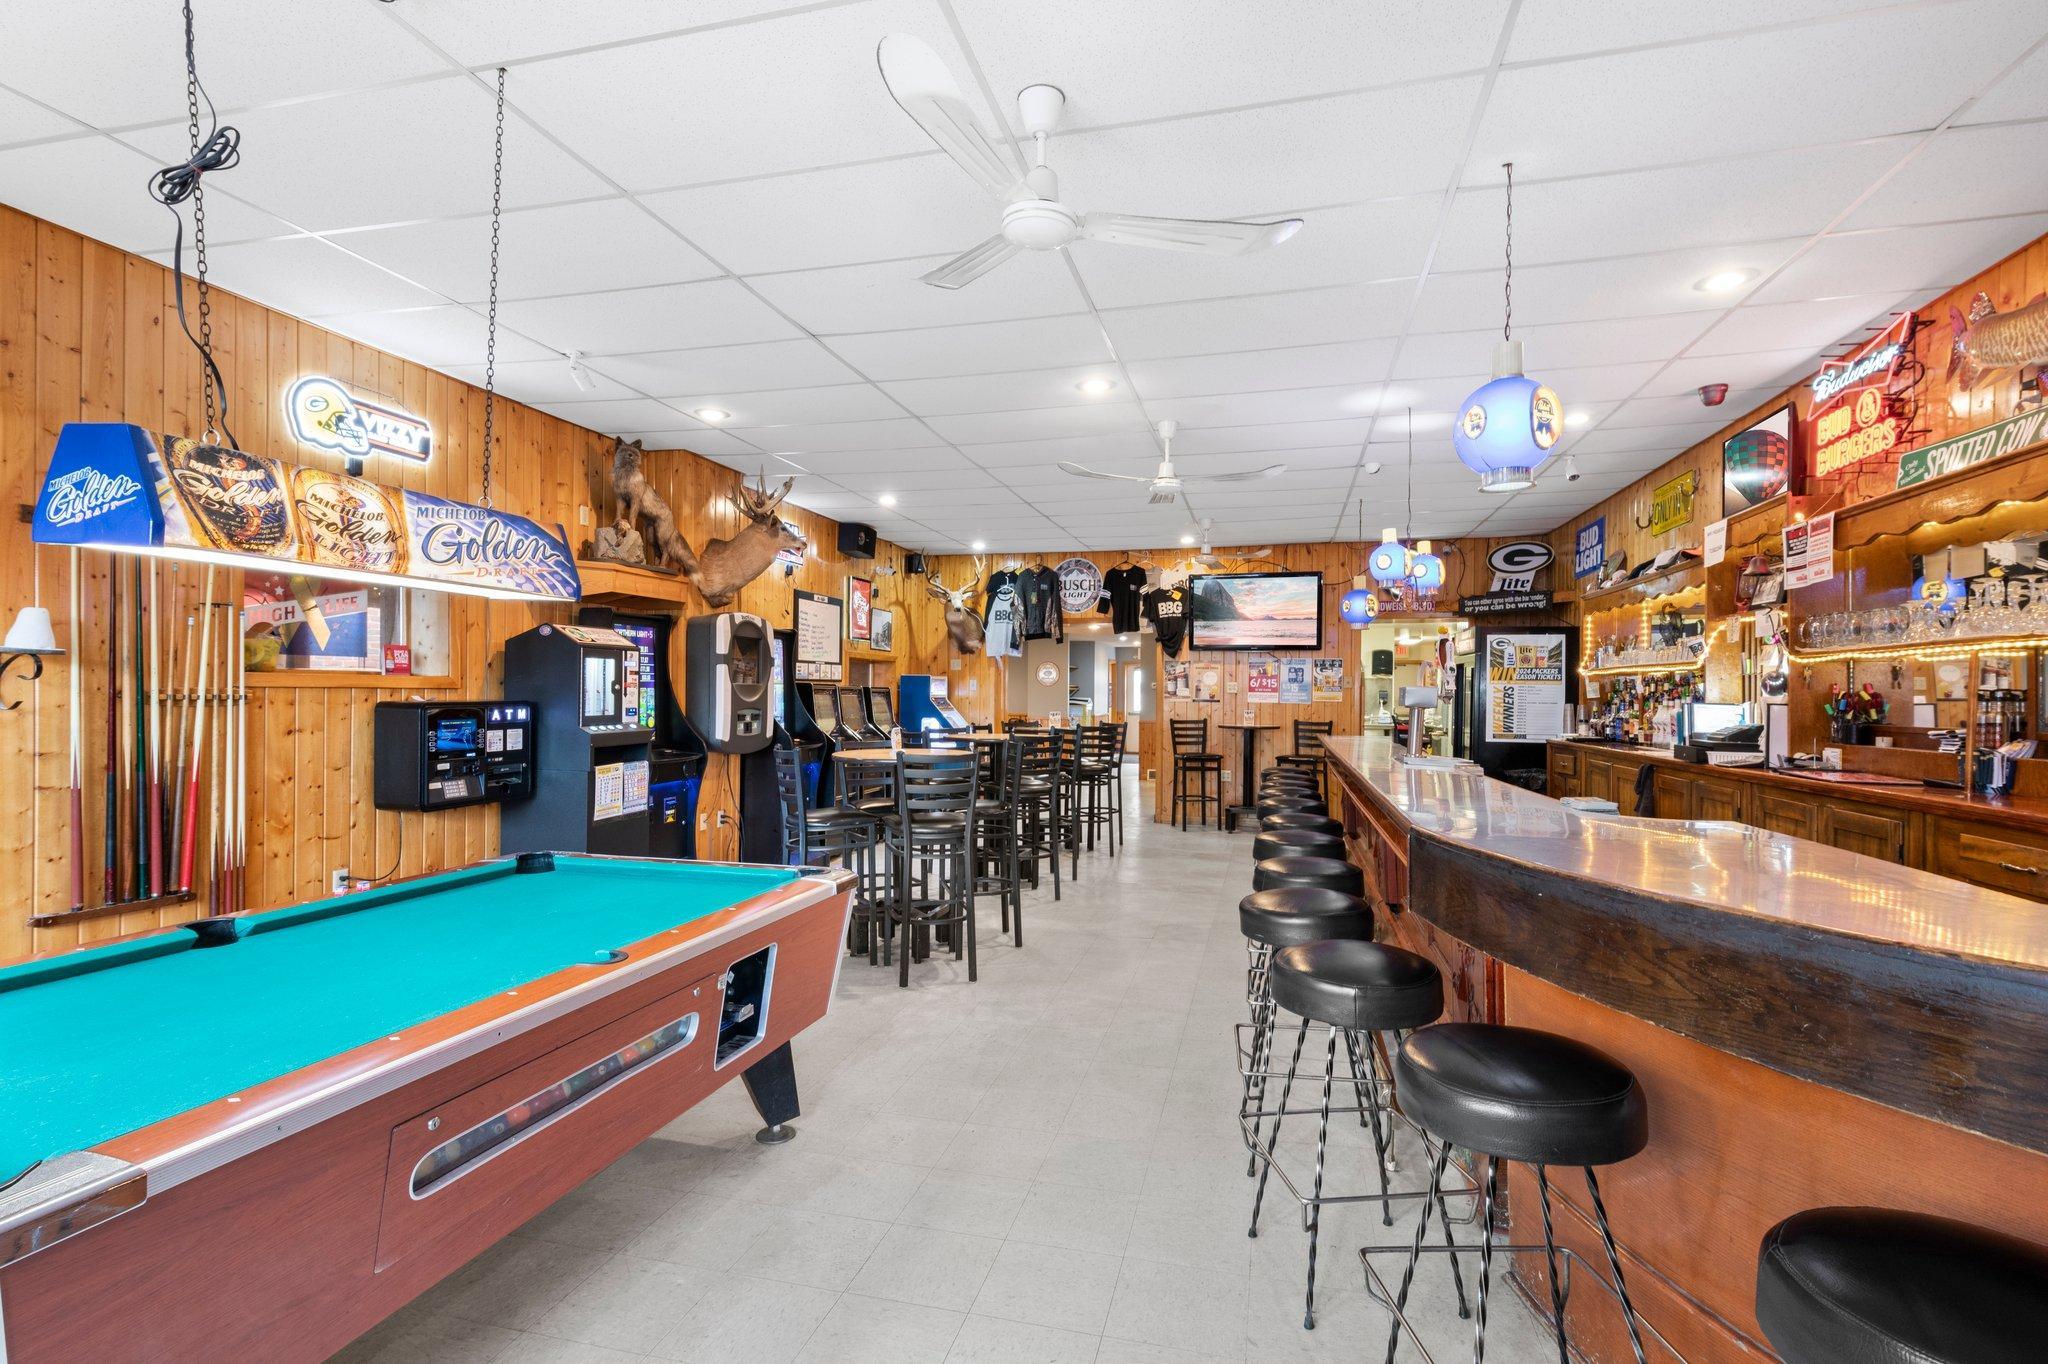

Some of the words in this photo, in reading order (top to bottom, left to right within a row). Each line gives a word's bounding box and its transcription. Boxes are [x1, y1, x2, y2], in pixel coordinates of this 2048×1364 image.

[1813, 344, 1899, 402] Budweiser
[1817, 405, 1851, 446] BUD
[1816, 417, 1896, 478] BURGERS
[1924, 430, 1997, 481] SPOTTED
[1996, 412, 2047, 457] COW
[48, 466, 92, 492] MICHELOB
[188, 458, 266, 480] MICHELOB
[45, 469, 142, 523] Golden
[173, 468, 283, 508] Golden
[74, 502, 117, 524] DRAFT
[310, 493, 384, 521] MICHELOB
[416, 506, 487, 521] MICHELOB
[295, 499, 402, 545] Golden
[313, 533, 397, 564] LIGHT
[421, 519, 561, 566] Golden
[1579, 525, 1599, 549] BUD
[475, 566, 539, 578] DRAFT
[1575, 544, 1603, 574] LIGHT
[1059, 579, 1097, 592] BUSCH
[325, 596, 359, 614] LIFE
[1158, 601, 1183, 615] BBG
[1474, 605, 1489, 614] you
[1490, 603, 1504, 611] can
[1517, 600, 1547, 609] wrong!
[1250, 679, 1260, 688] 6/
[1262, 679, 1278, 688] $15
[1490, 667, 1516, 681] WIN
[492, 708, 527, 721] ATM
[1493, 686, 1504, 733] WEEKLY
[1503, 685, 1515, 733] WINNERS
